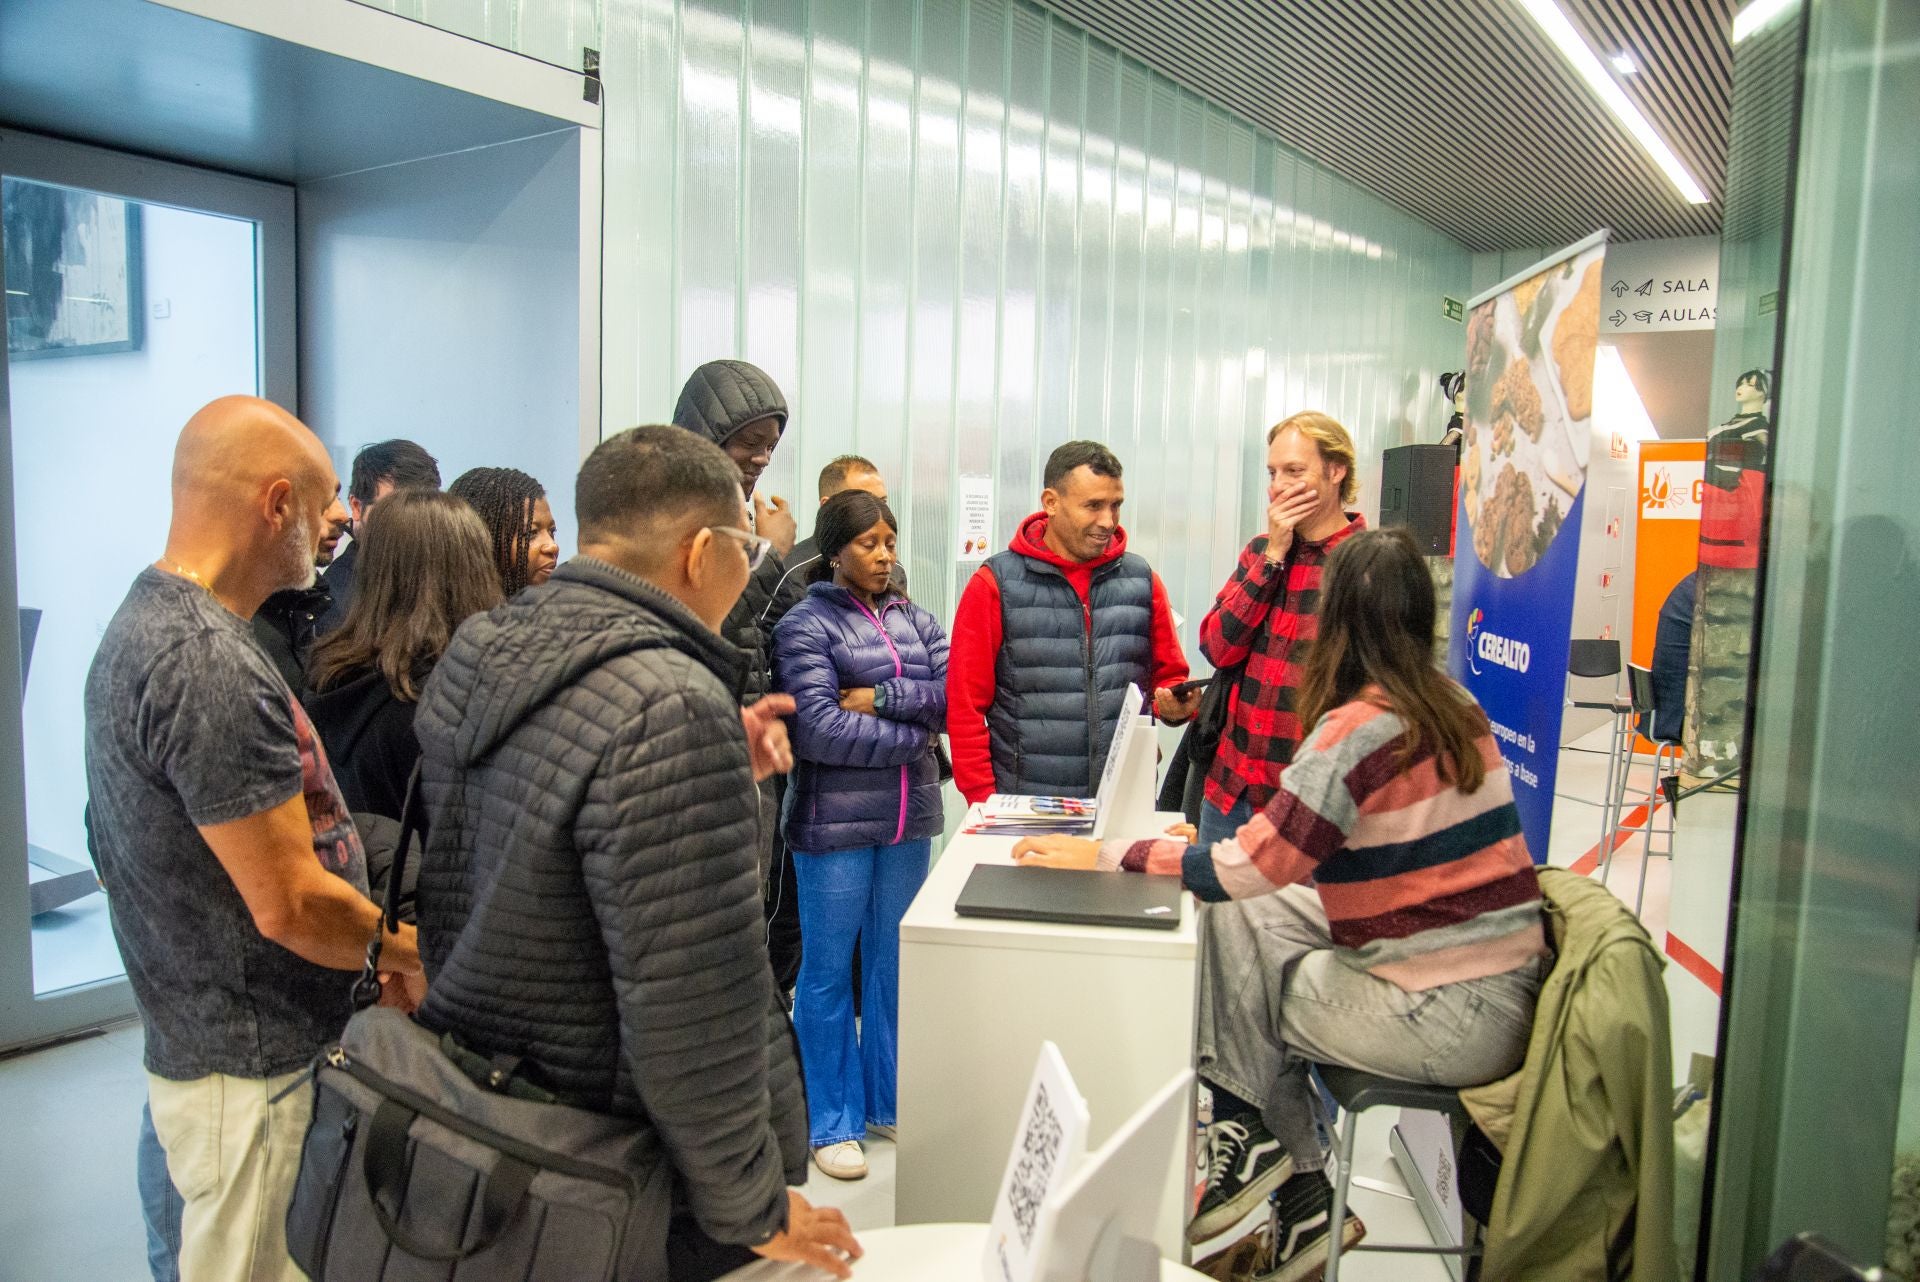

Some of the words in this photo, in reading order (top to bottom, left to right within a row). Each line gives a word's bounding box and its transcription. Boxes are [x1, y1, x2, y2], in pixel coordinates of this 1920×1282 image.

[1662, 279, 1709, 294] SALA
[1478, 631, 1530, 673] CEREALTO
[1490, 720, 1517, 743] europeo
[1517, 734, 1527, 749] en
[1527, 733, 1536, 753] la
[1520, 763, 1538, 788] base
